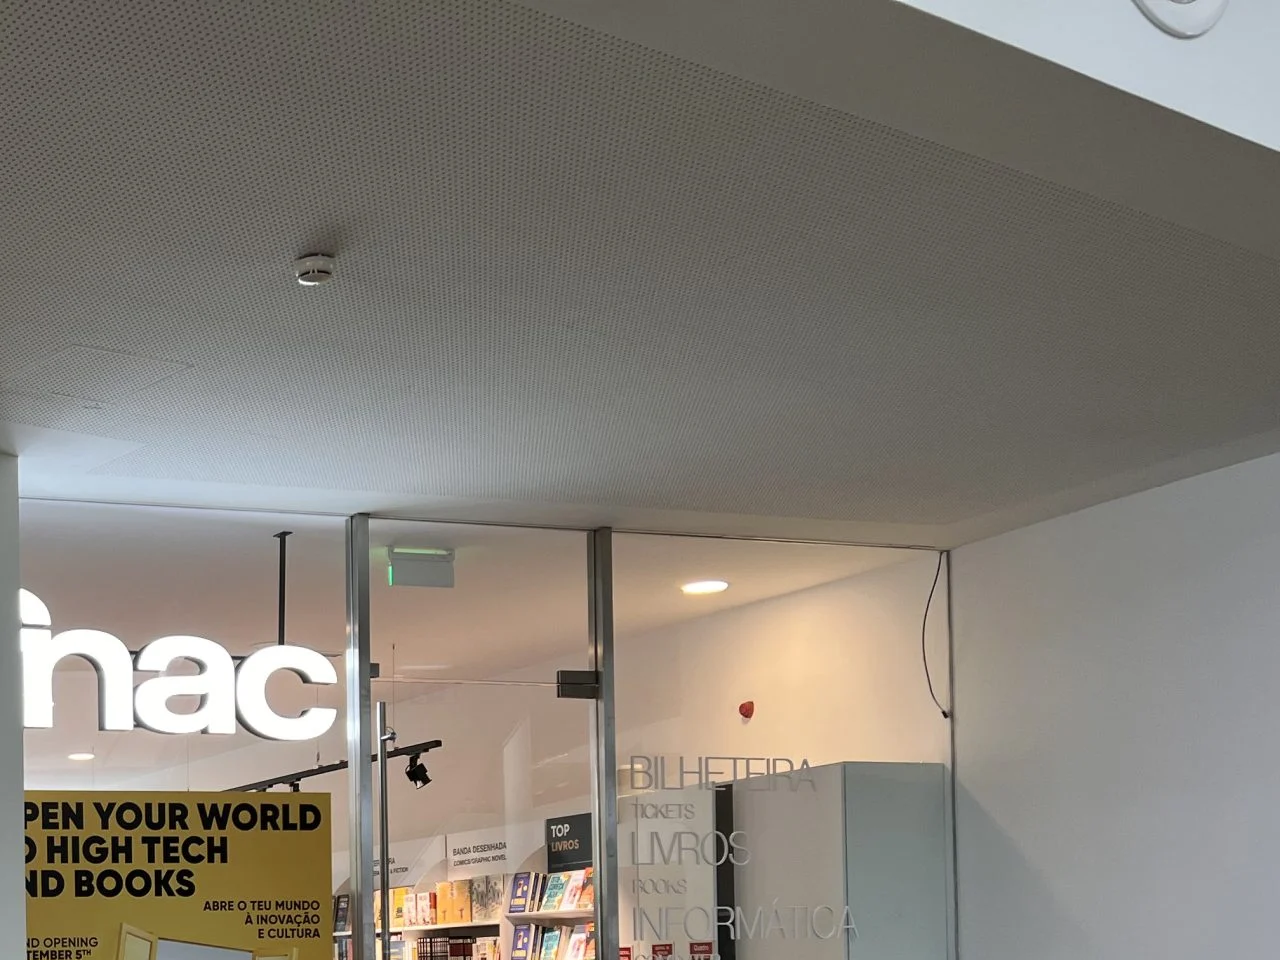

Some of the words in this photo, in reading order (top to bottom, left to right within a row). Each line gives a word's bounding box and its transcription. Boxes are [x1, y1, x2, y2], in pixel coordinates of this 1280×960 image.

[20, 588, 338, 741] nac
[630, 756, 816, 792] BILHETEIRA
[24, 802, 84, 831] PEN
[93, 802, 189, 831] YOUR
[198, 803, 322, 832] WORLD
[632, 804, 696, 820] TICKETS
[551, 824, 570, 838] TOP
[47, 835, 133, 864] HIGH
[141, 836, 228, 864] TECH
[452, 848, 471, 856] BANDA
[472, 842, 507, 853] DESENHADA
[551, 838, 580, 852] LIVROS
[631, 830, 752, 866] LIVROS
[74, 868, 196, 898] BOOKS
[632, 879, 688, 895] BOOKS
[203, 900, 234, 912] ABRE
[237, 900, 247, 912] O
[249, 900, 272, 911] TEU
[275, 900, 320, 911] MUNDO
[244, 911, 254, 925] À
[256, 911, 320, 928] INOVAÇÃO
[633, 897, 860, 941] INFORMÁTICA
[258, 929, 265, 939] E
[267, 928, 321, 939] CULTURA
[43, 937, 99, 948] OPENING
[26, 949, 72, 960] TEMBER
[75, 949, 92, 960] 5TH
